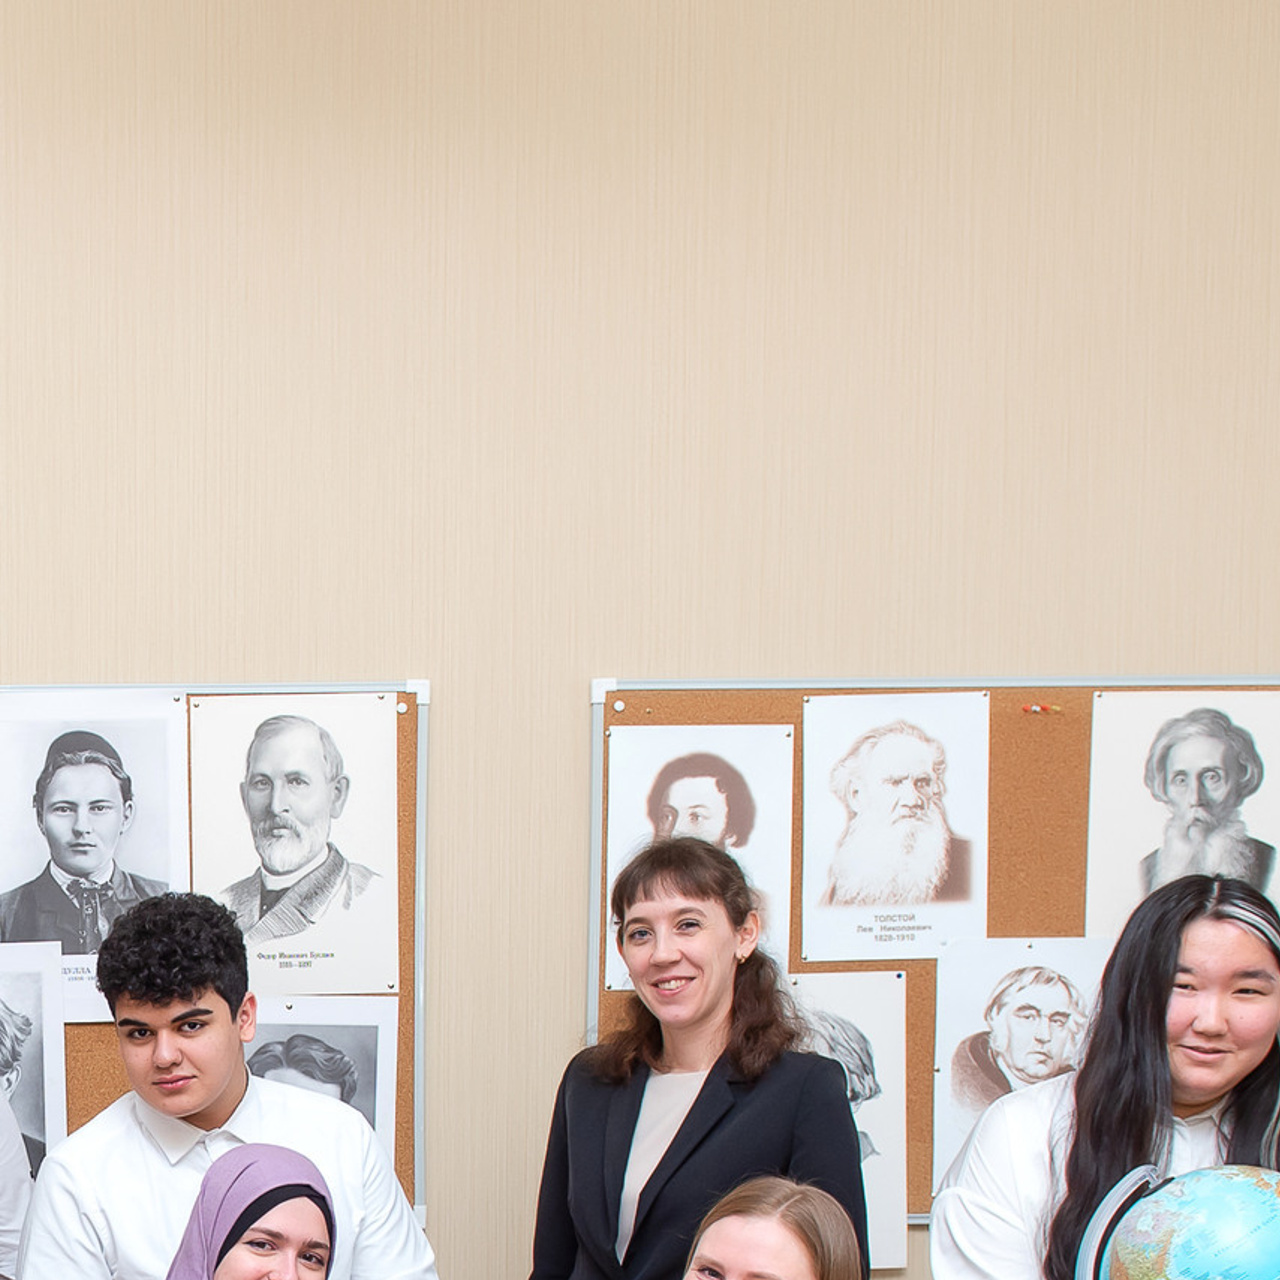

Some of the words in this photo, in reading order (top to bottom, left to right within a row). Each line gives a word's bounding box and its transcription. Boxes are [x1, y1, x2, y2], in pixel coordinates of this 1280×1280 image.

[874, 913, 916, 923] ТОЛСТОЙ
[856, 925, 873, 933] Лев
[880, 924, 932, 932] Николаевич
[874, 934, 916, 942] 1828-1910
